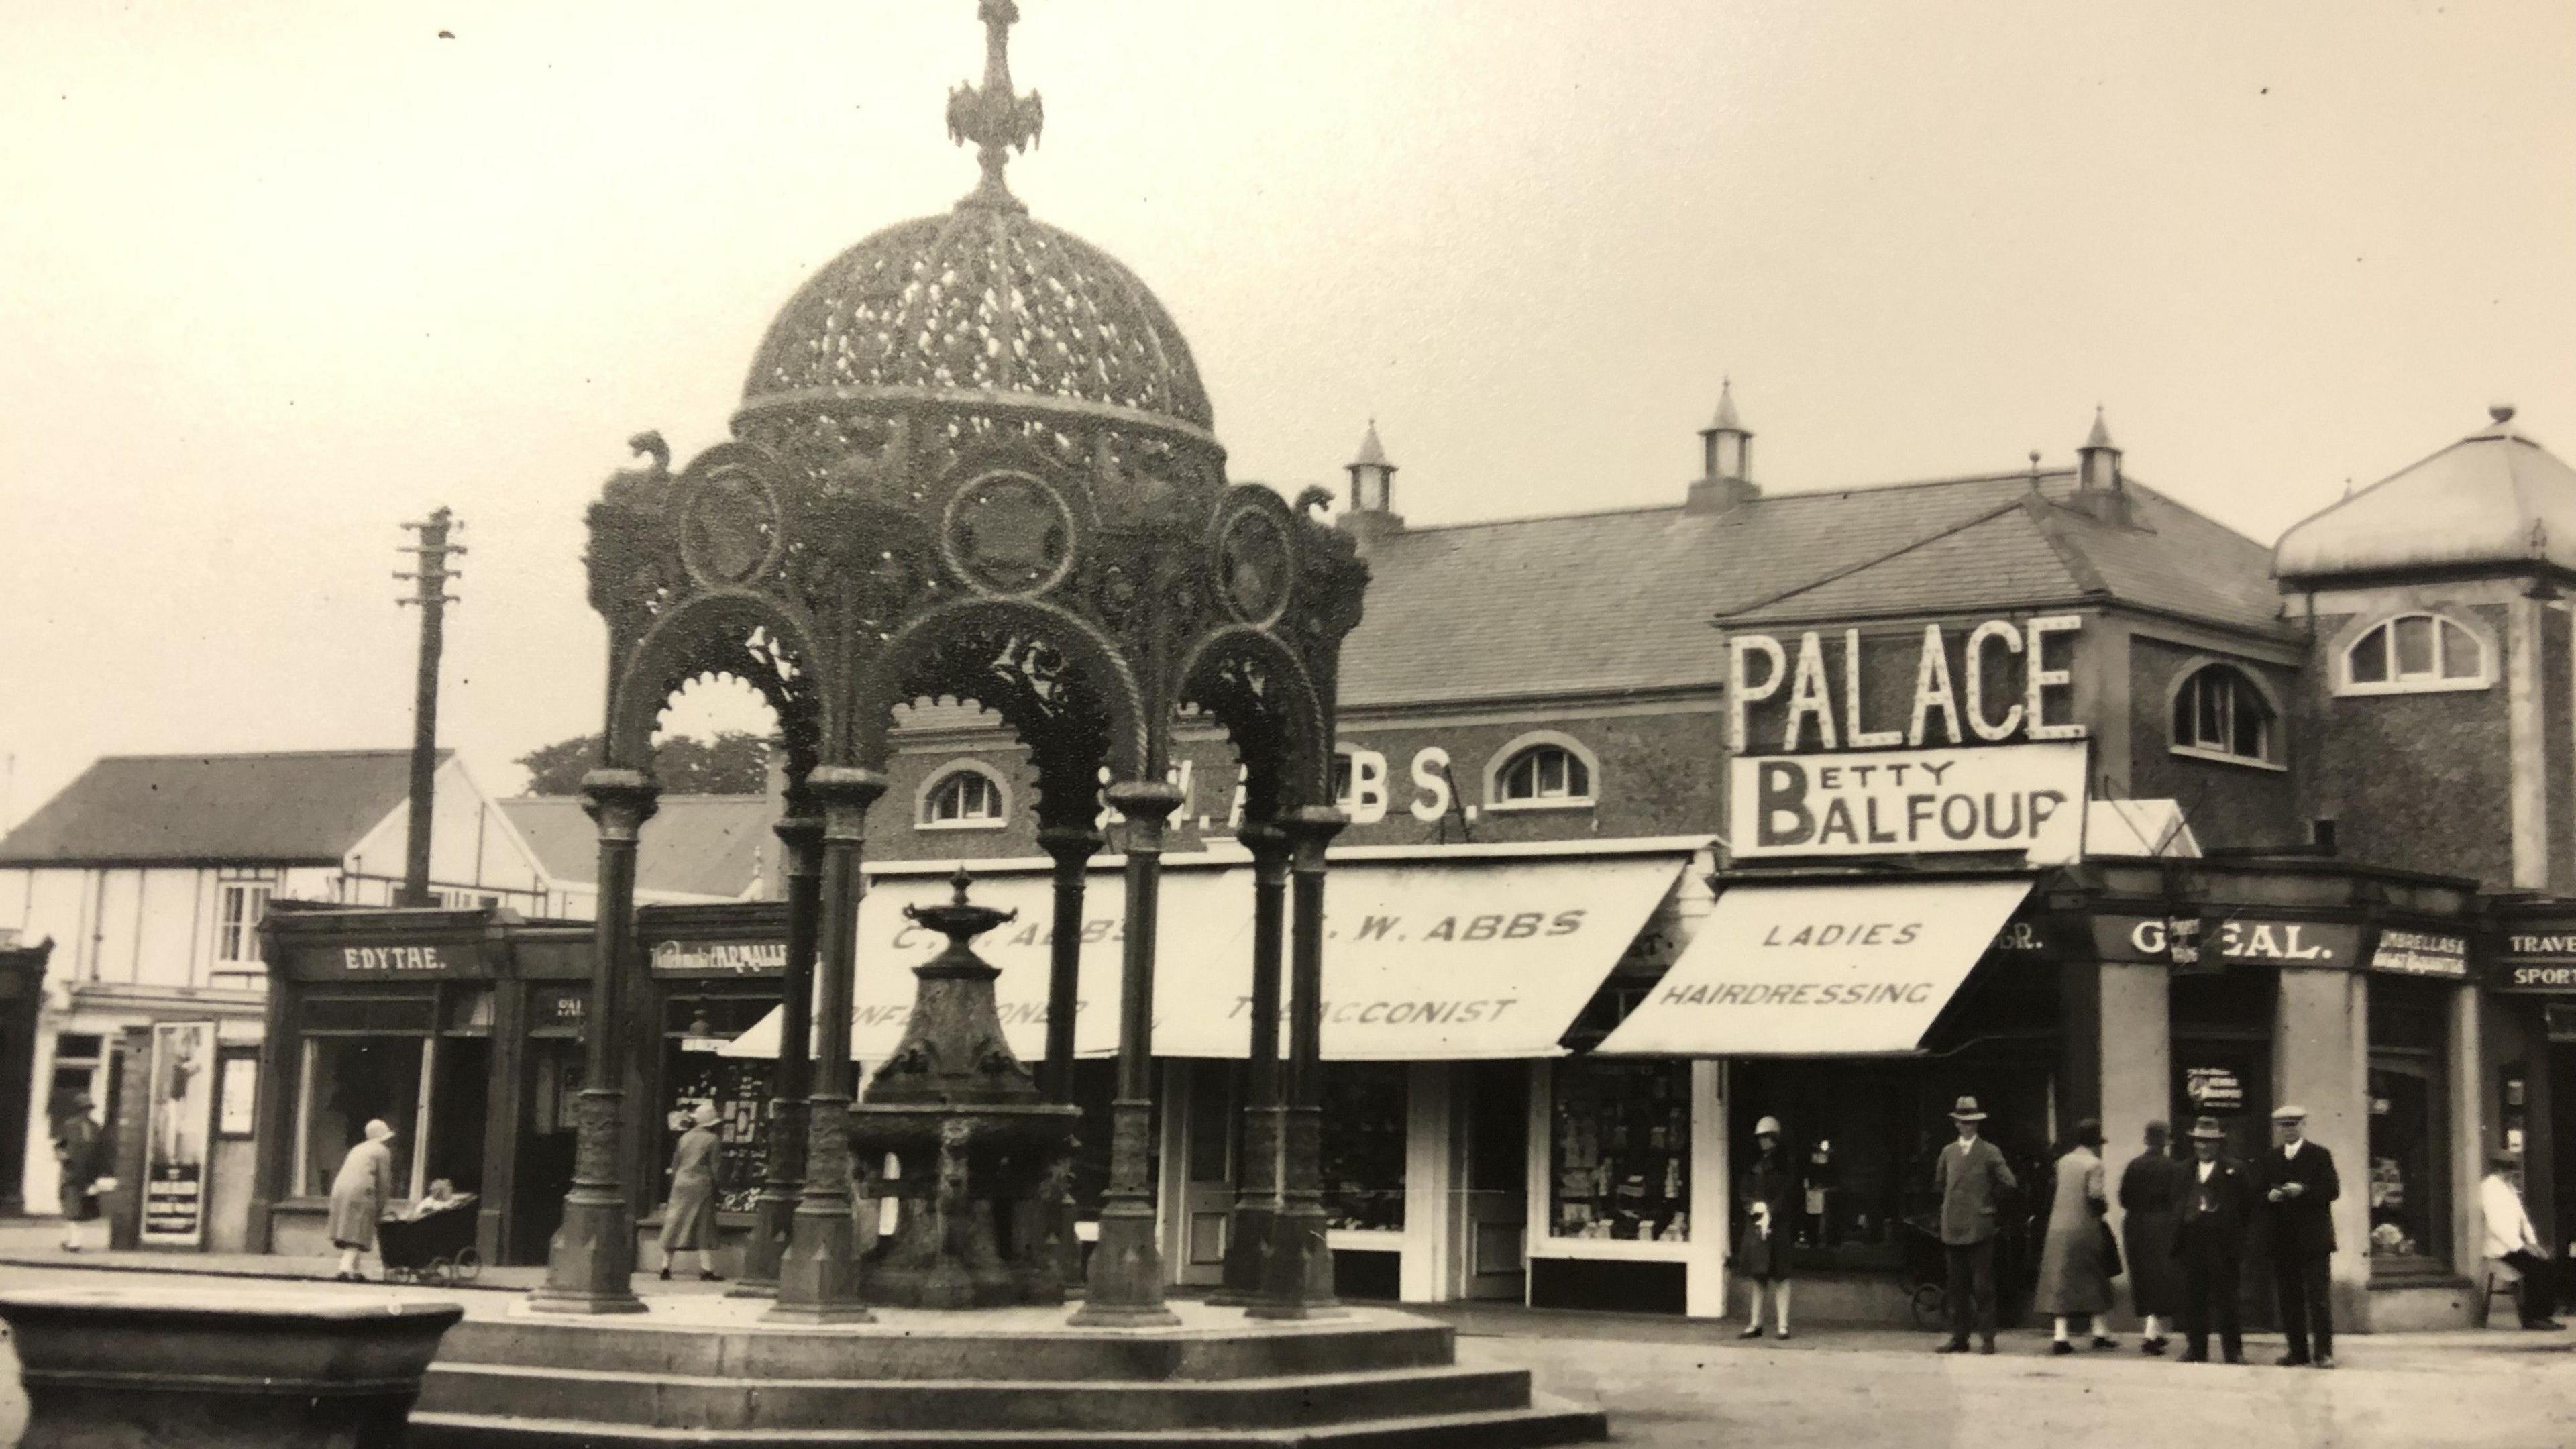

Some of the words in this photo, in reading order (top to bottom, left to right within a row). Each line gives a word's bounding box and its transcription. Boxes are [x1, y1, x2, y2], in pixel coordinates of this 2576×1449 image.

[1728, 615, 2088, 753] PALACE
[1756, 760, 1956, 847] BETTY
[1421, 908, 1589, 941] ABBS
[1762, 922, 1923, 947] LADIES
[1659, 983, 1935, 1006] HAIRDRESSING
